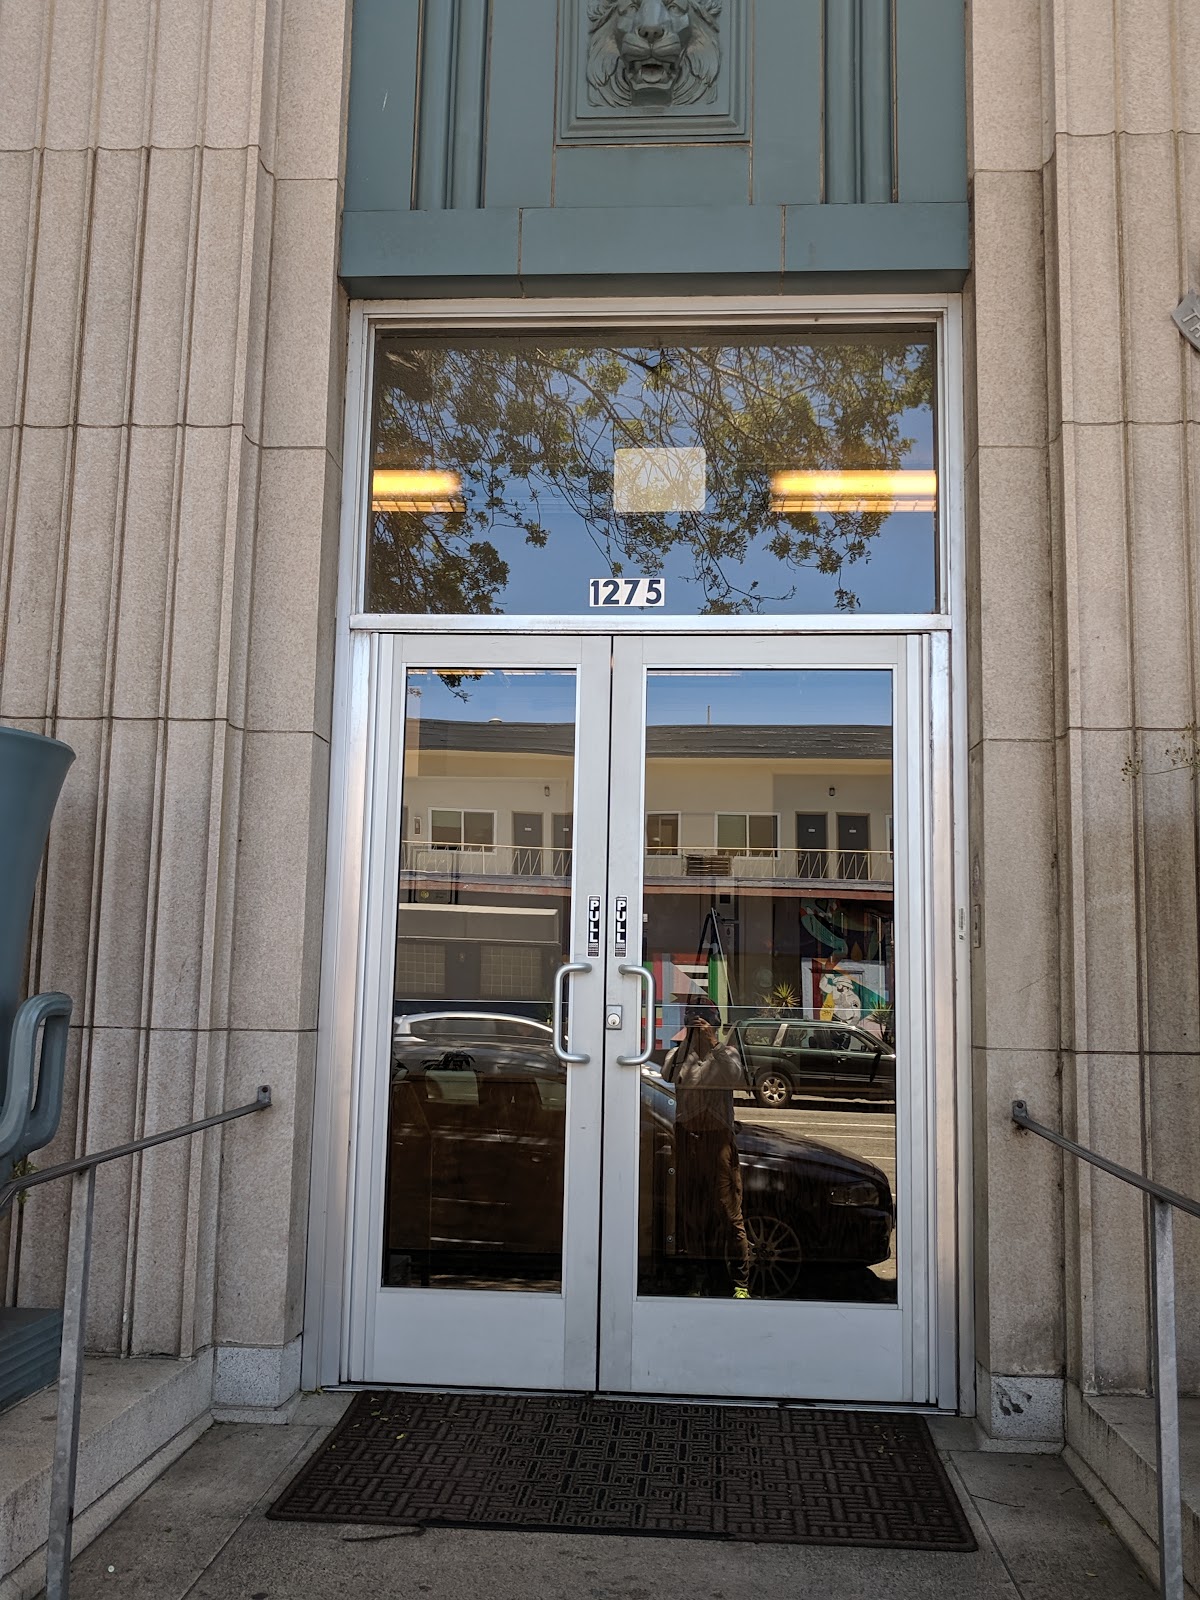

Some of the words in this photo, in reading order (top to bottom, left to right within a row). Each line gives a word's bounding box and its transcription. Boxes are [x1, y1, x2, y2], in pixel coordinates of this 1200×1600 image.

[590, 579, 662, 606] 1275
[588, 900, 600, 943] PULL
[616, 900, 627, 943] PULL
